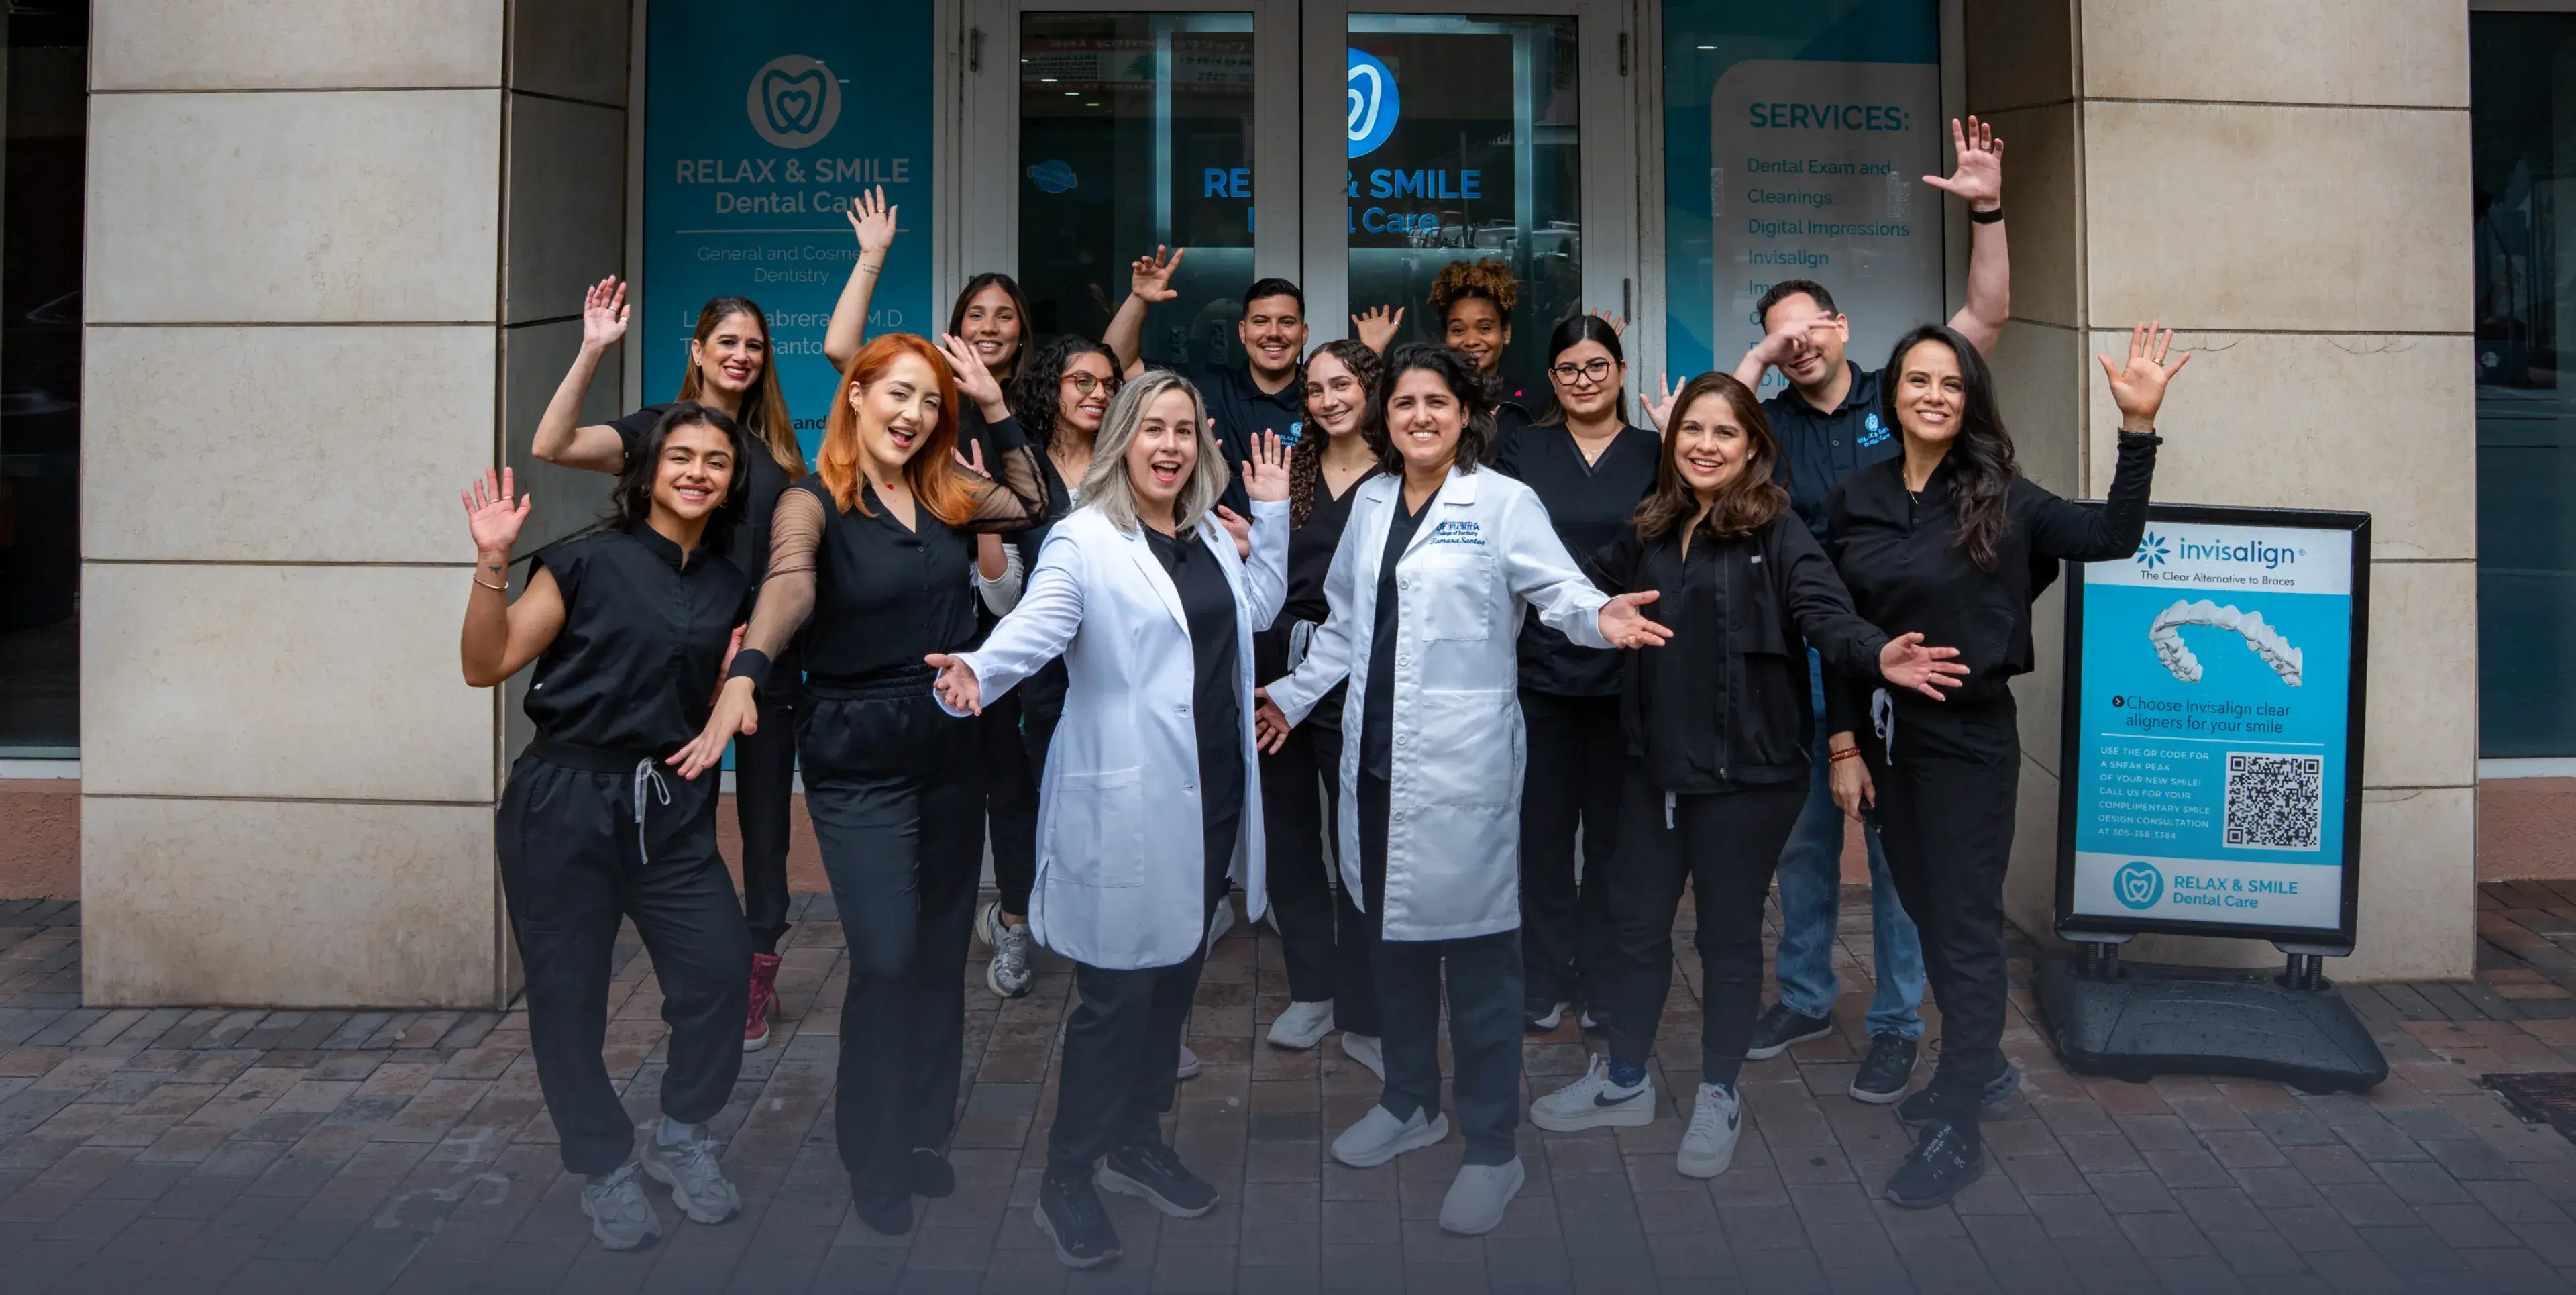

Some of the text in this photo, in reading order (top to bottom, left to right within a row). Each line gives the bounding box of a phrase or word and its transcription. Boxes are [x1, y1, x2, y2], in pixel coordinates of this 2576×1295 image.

[1750, 103, 1910, 130] SERVICES:
[677, 158, 909, 183] RELAX & SMILE
[1748, 159, 1890, 174] Dental Exam and
[1370, 169, 1481, 198] SMILE
[716, 191, 806, 213] Dental
[1748, 190, 1832, 207] Cleanings
[1362, 207, 1438, 234] Care
[1749, 220, 1909, 238] Digital Impressions
[698, 247, 860, 260] General and Cosme
[1750, 250, 1829, 268] Invisalign
[755, 268, 829, 285] Dentistry
[765, 309, 830, 326] abrera
[771, 338, 824, 354] Santo
[2141, 570, 2294, 586] The Clear Alternative to Braces
[2127, 696, 2290, 718] Choose Invisalign clear
[2126, 712, 2282, 734] aligners for your smile
[2101, 747, 2118, 756] USE
[2123, 747, 2141, 756] THE
[2160, 750, 2186, 759] CODE
[2190, 751, 2209, 760] FOR
[2110, 761, 2142, 770] SNEAK
[2145, 763, 2169, 772] PEAK
[2100, 774, 2200, 786] OF YOUR NEW SMILE!
[2100, 788, 2190, 799] CALL US FOR YOUR
[2100, 801, 2210, 814] COMPLIMENTARY SMILE
[2099, 815, 2208, 827] DESIGN CONSULTATION
[2174, 876, 2298, 894] RELAX & SMILE
[2174, 893, 2257, 908] Dental Care
